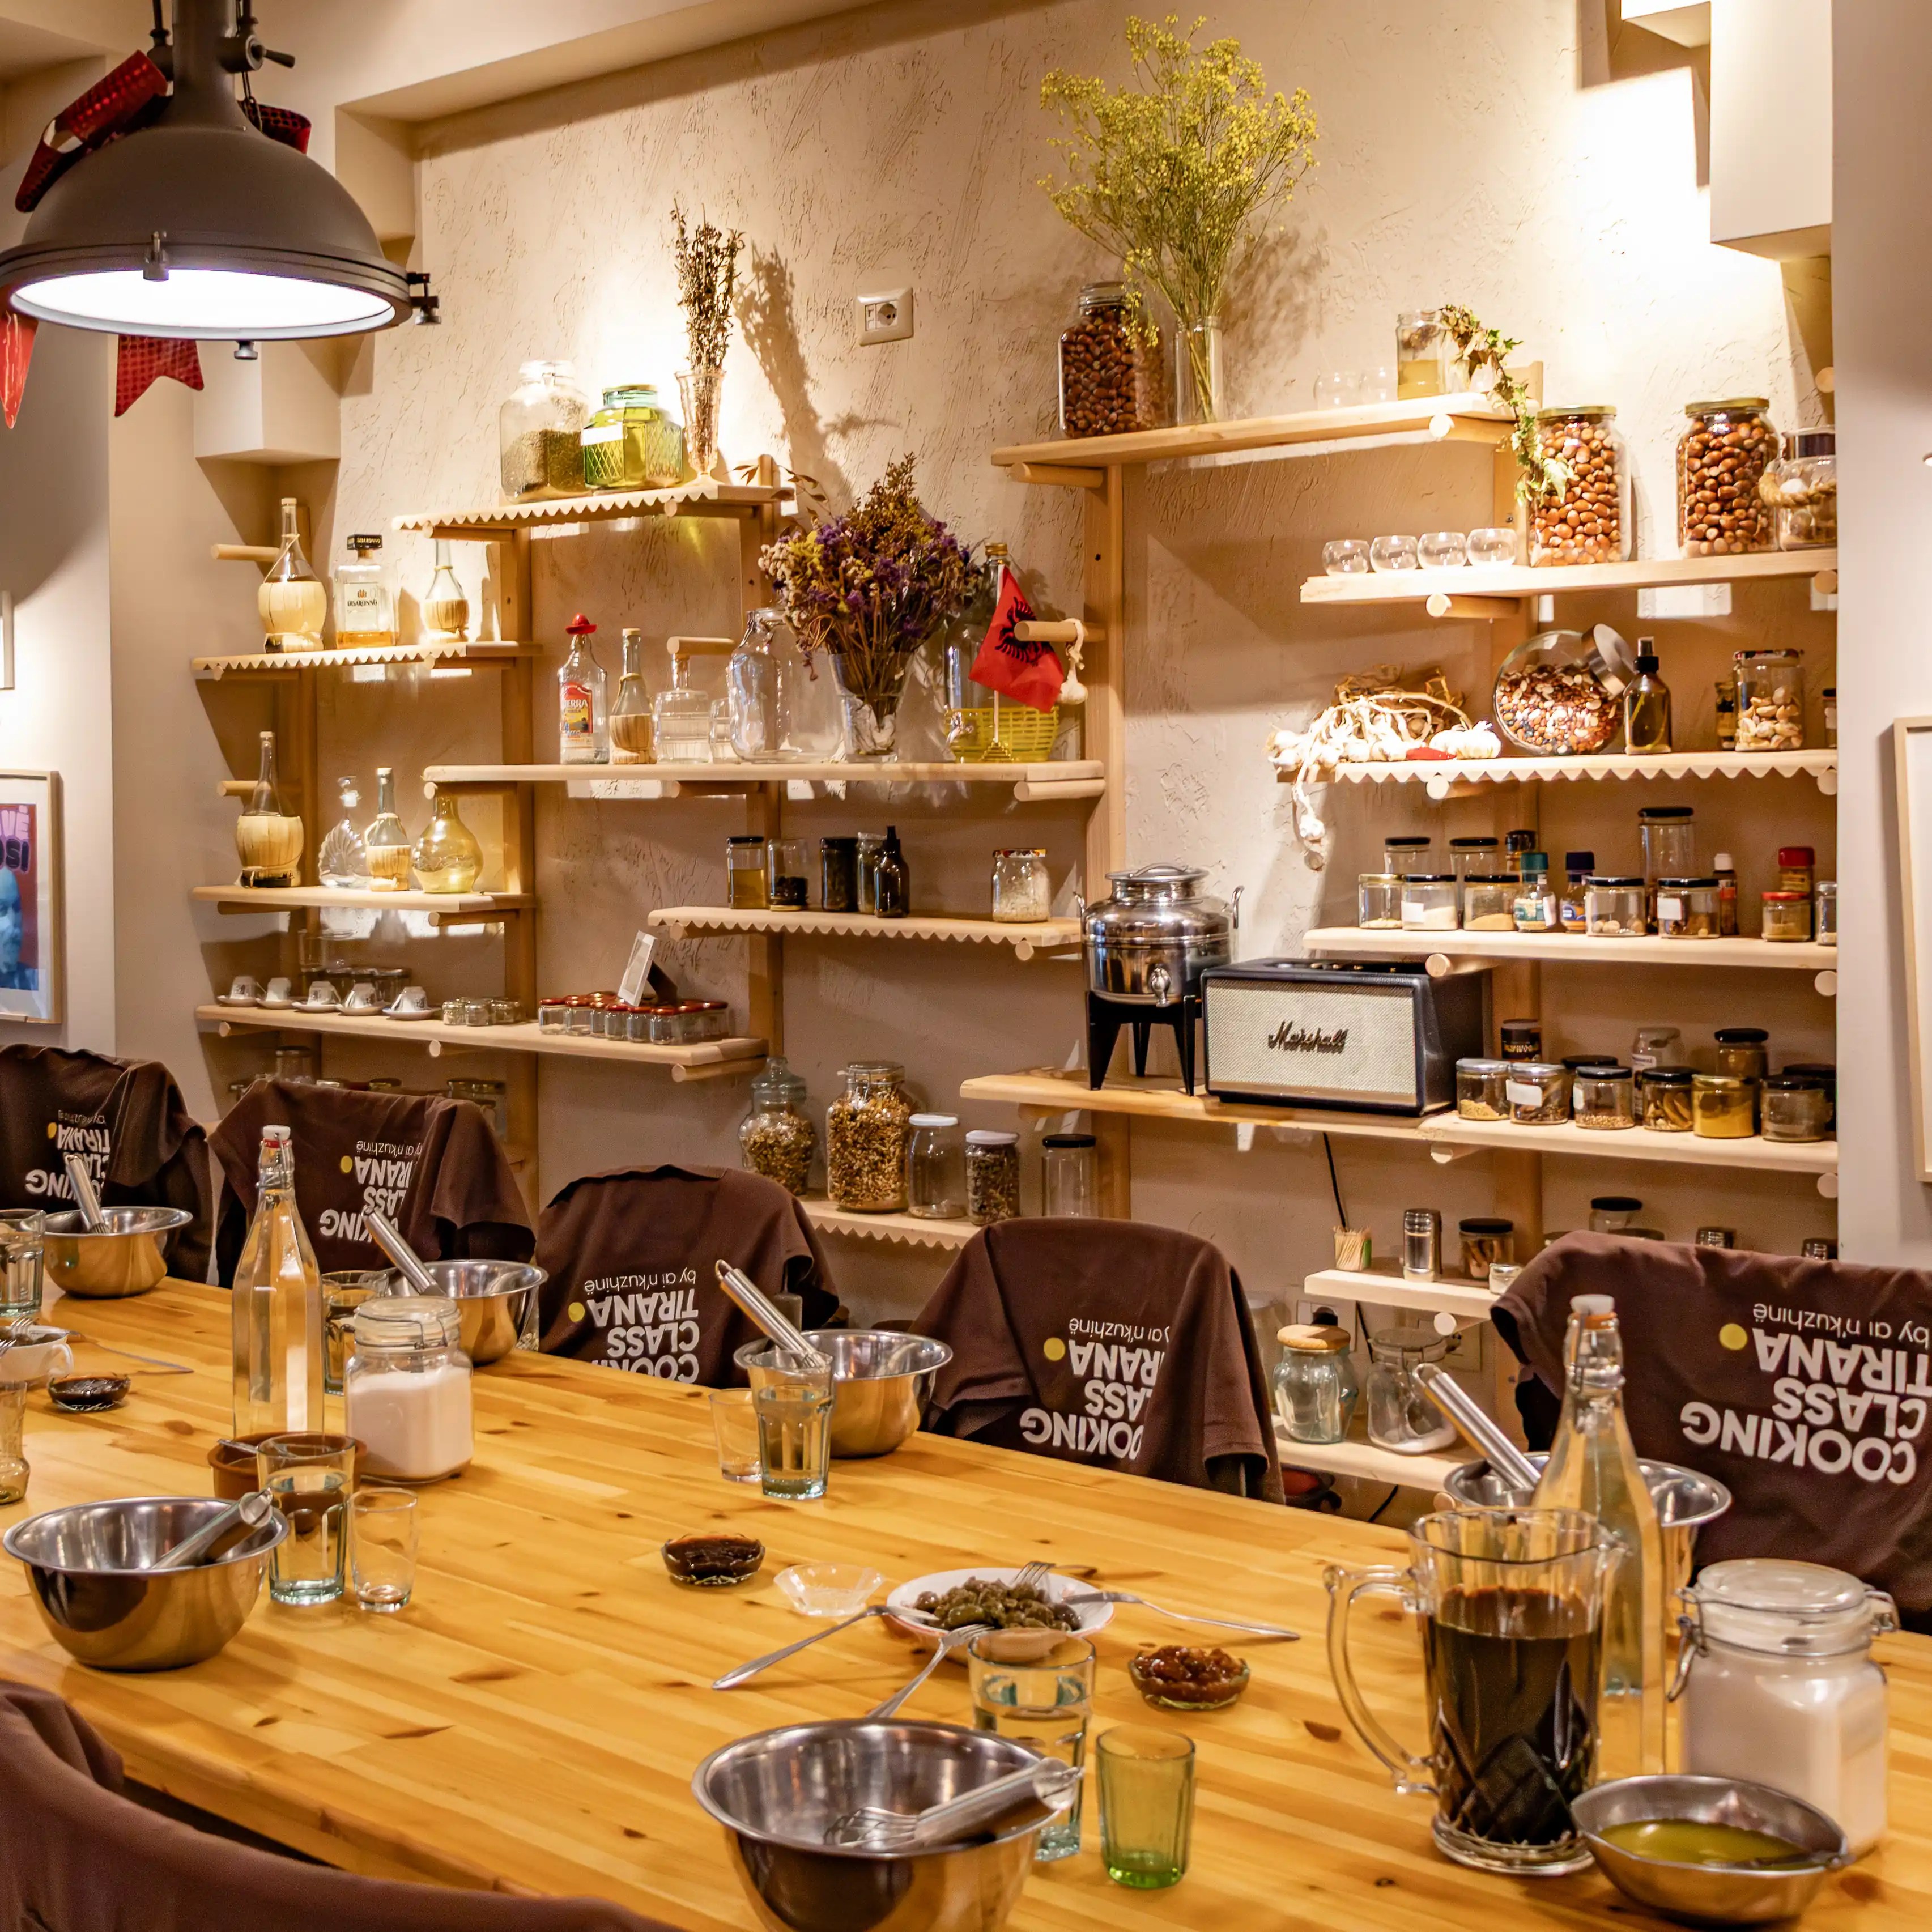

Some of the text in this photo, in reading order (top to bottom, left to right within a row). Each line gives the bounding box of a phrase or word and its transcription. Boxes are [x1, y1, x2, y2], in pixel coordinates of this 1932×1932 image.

[1268, 1020, 1349, 1053] Marshall
[354, 1156, 413, 1188] IRANA
[363, 1186, 407, 1216] LASS
[584, 1267, 696, 1295] by ai n'kuzhinë
[586, 1288, 699, 1327] TIRANA
[1752, 1303, 1861, 1339] n'kuzhinë
[607, 1320, 700, 1357] CLASS
[1069, 1318, 1145, 1343] n'kuzhinë
[1898, 1320, 1930, 1349] by
[1752, 1327, 1932, 1398] TIRANA
[1772, 1377, 1926, 1439] CLASS
[1020, 1408, 1144, 1460] OOKING
[1680, 1401, 1917, 1485] COOKING
